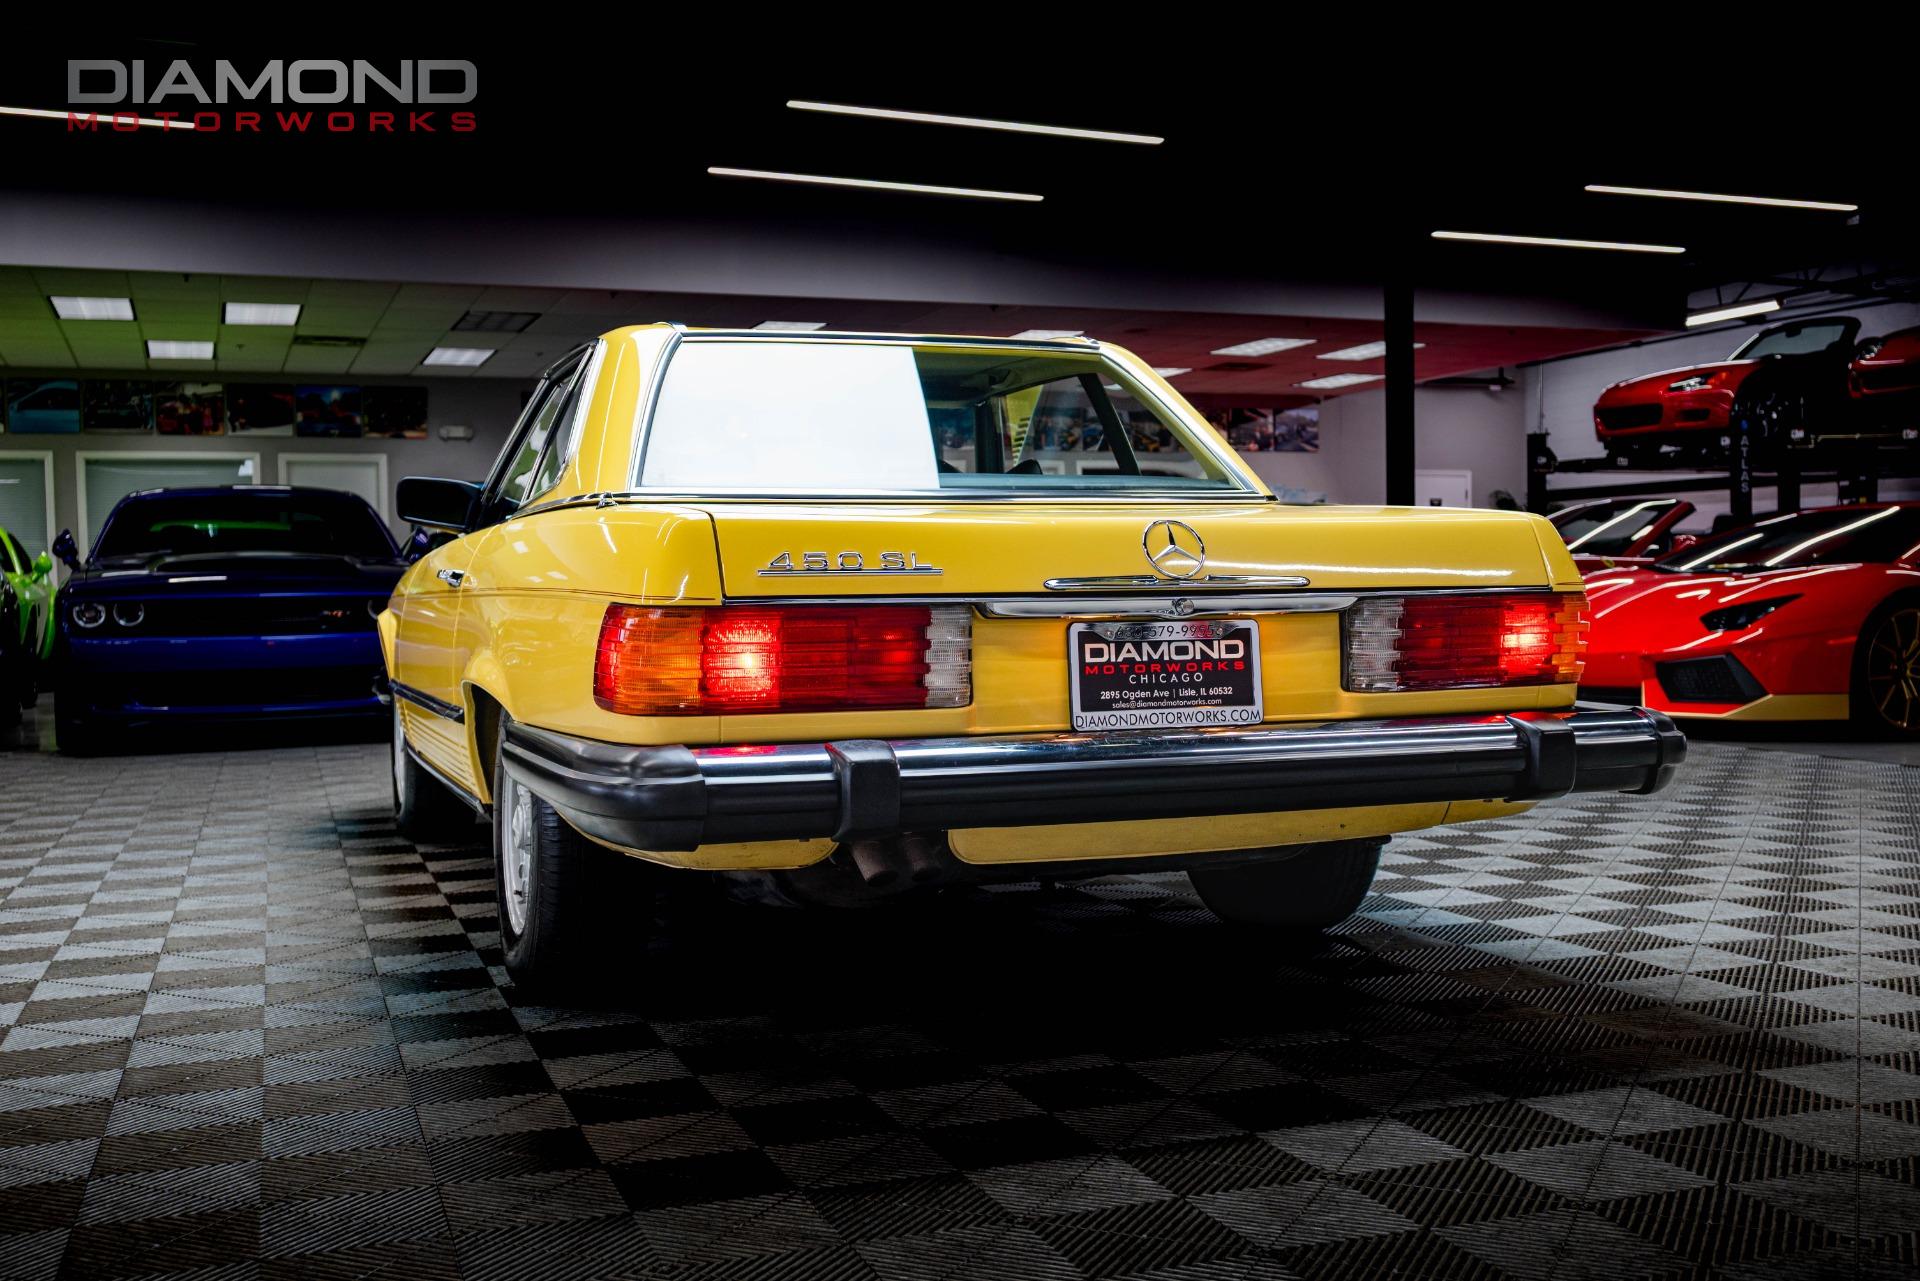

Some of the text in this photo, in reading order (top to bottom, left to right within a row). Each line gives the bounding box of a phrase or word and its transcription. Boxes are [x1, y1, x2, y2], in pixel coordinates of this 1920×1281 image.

[1740, 435, 1750, 493] ATLAS
[768, 551, 933, 570] 450 SL
[1084, 639, 1245, 663] DIAMOND
[1084, 660, 1246, 675] MOTORWORKS
[1128, 672, 1204, 685] CHICAGO
[1100, 686, 1233, 701] 2895 Ogden Ave Lisle, IL 60532
[1111, 698, 1223, 709] sales@diamondmotorworks.com
[1075, 709, 1261, 729] DIAMONDMOTORWORKS.COM
